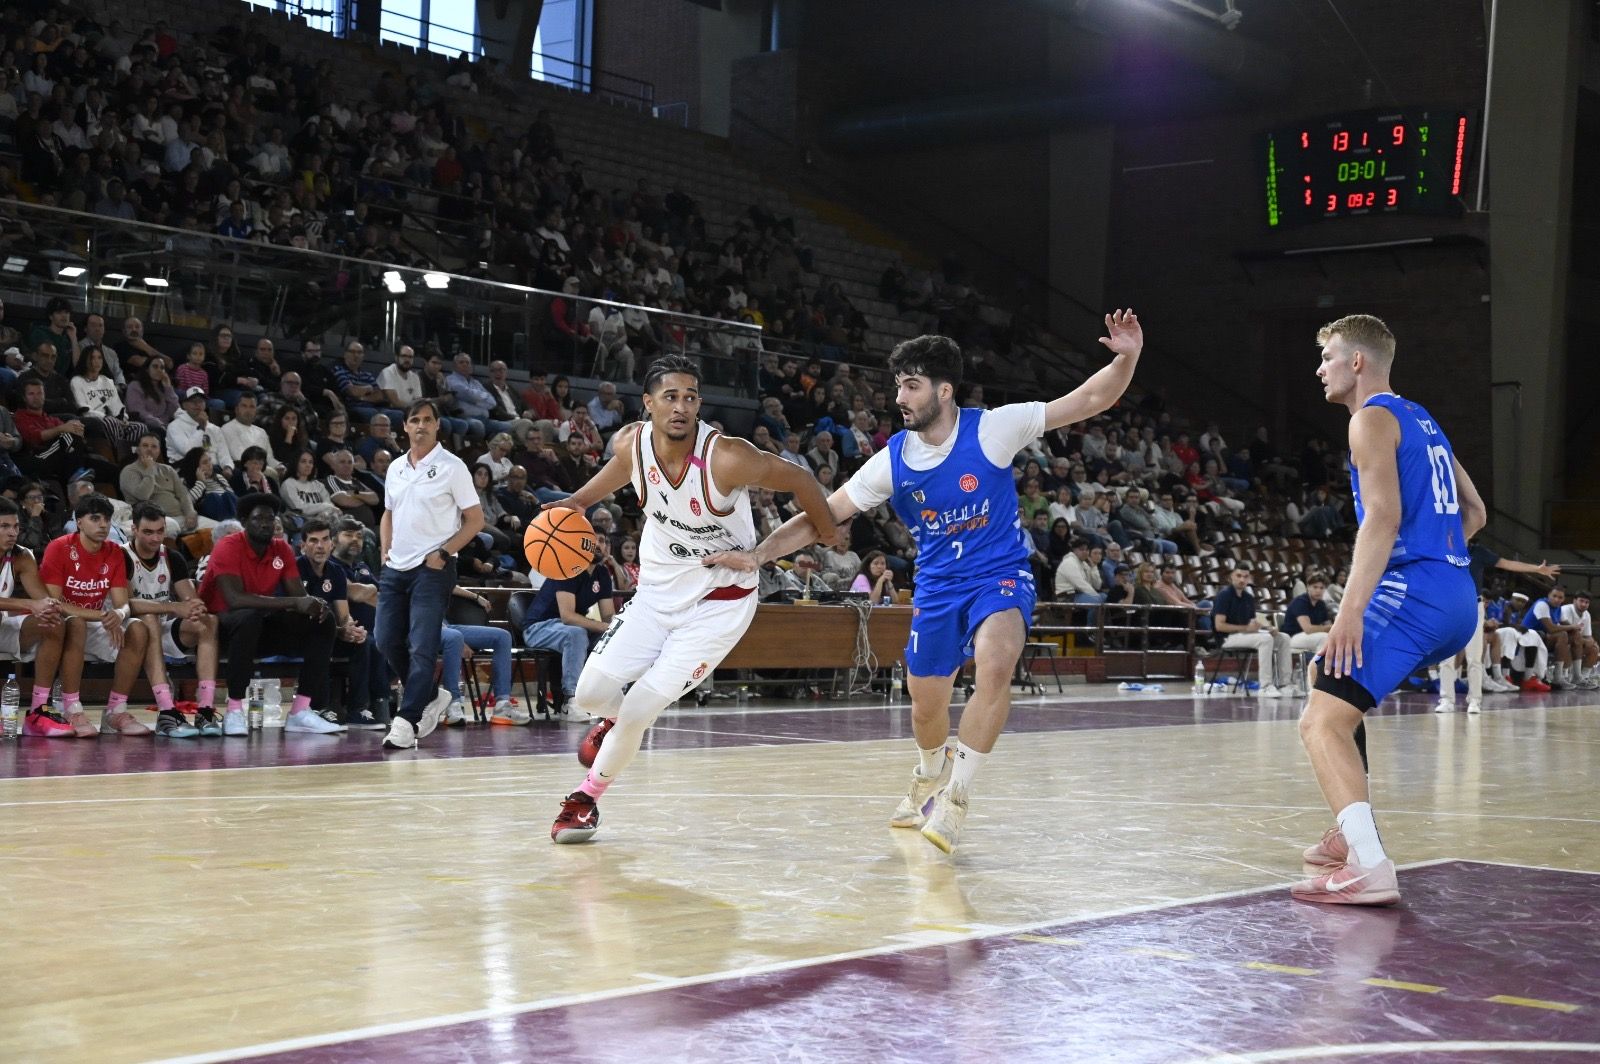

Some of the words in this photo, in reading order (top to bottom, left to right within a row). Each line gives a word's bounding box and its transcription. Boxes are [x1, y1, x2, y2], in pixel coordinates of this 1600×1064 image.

[1392, 125, 1405, 145] 9
[1337, 160, 1386, 182] 03:01
[1327, 194, 1337, 211] 3
[1387, 188, 1398, 206] 3
[1427, 444, 1459, 515] 10
[580, 537, 597, 554] Wil
[951, 541, 963, 560] 7
[910, 629, 919, 654] 7
